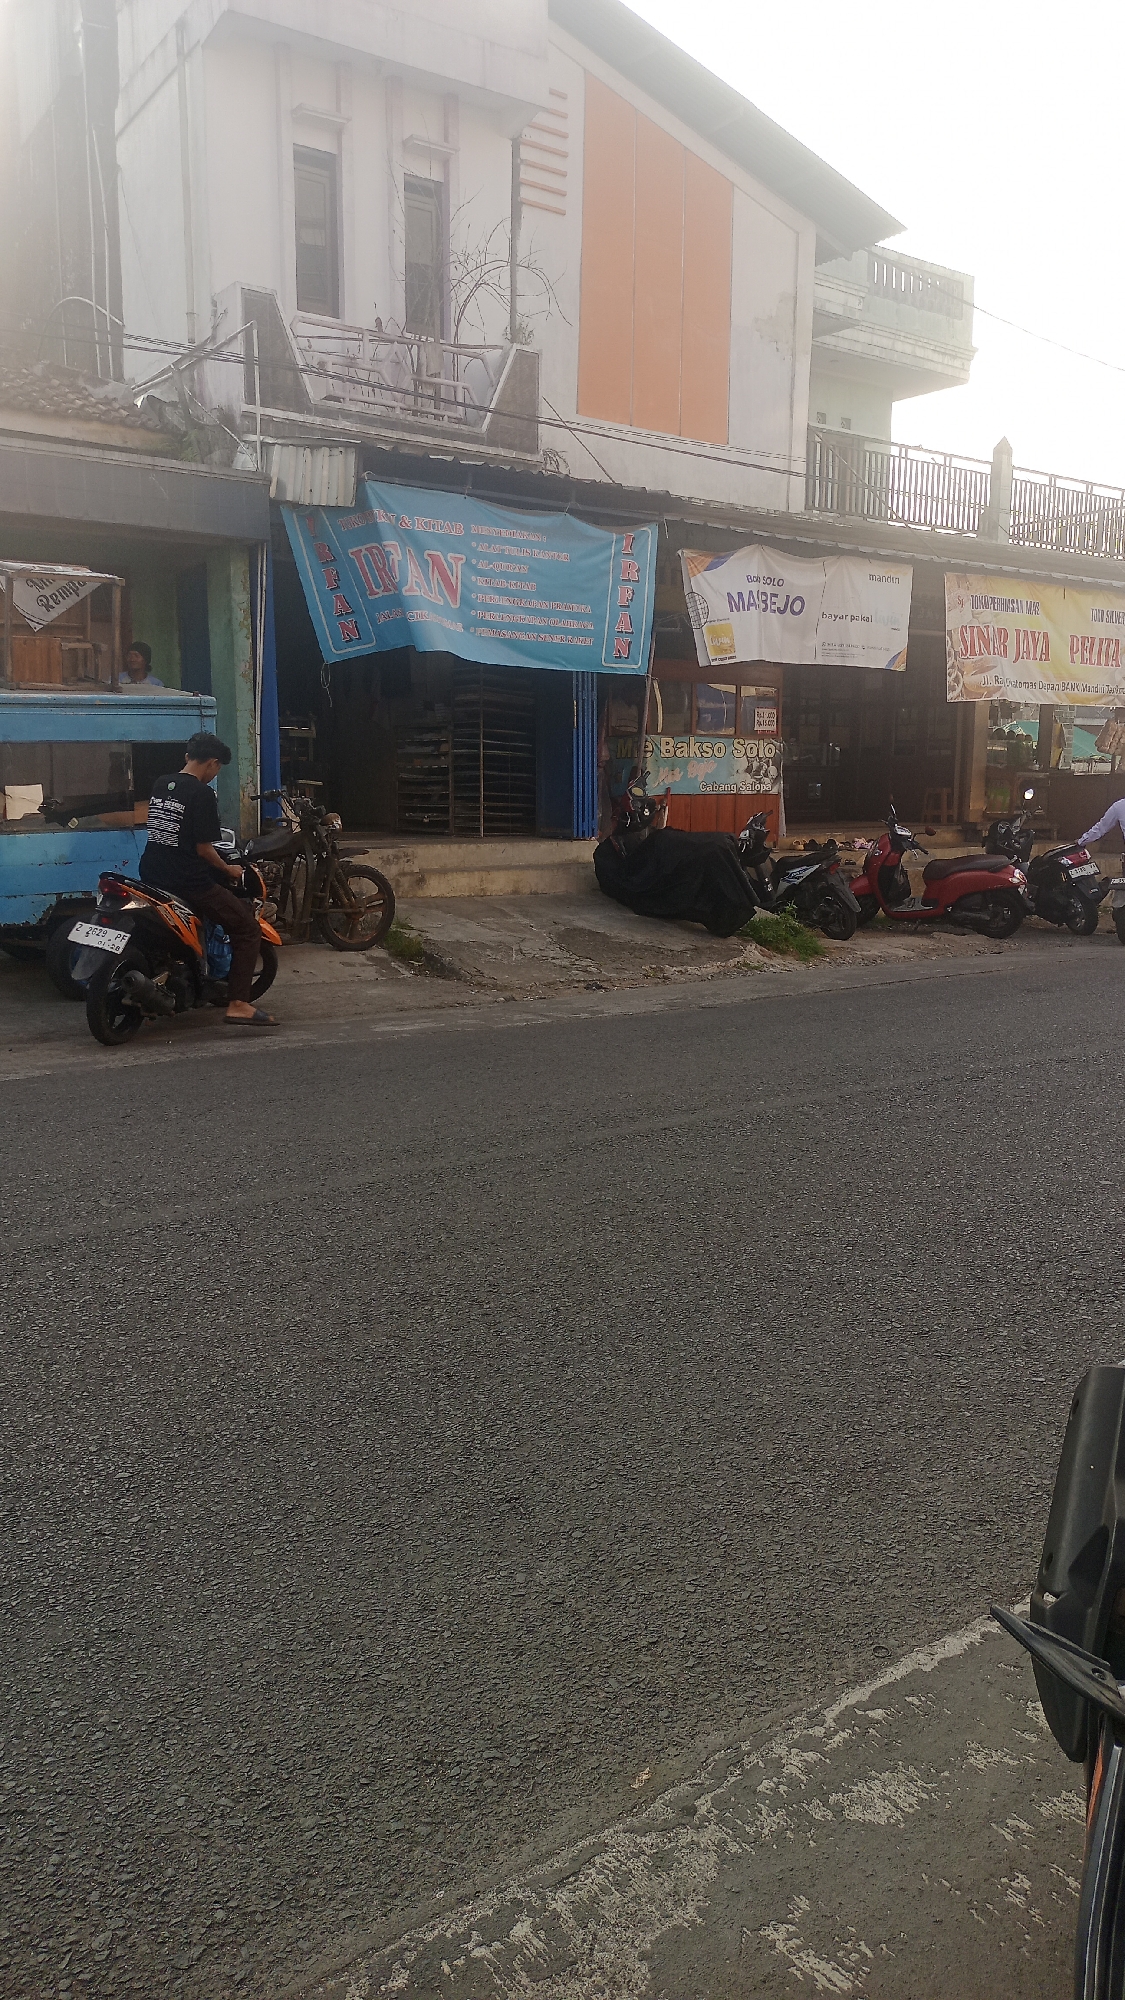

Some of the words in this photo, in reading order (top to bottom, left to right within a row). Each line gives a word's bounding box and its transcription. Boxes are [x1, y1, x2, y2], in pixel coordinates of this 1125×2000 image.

[399, 515, 413, 529] &
[414, 516, 465, 536] KITAB
[504, 545, 532, 557] TULIS
[532, 548, 570, 562] KANTOR
[348, 541, 467, 609] IRFAN
[477, 593, 550, 609] PERLENGKAPAN
[550, 601, 592, 614] PRAMUKA
[612, 532, 640, 659] IRFAN
[989, 596, 1024, 615] PERHIASAN
[1025, 600, 1040, 616] MAS
[477, 610, 548, 626] PERLENGKAPAN
[549, 617, 595, 630] OLAHRAGA
[821, 611, 849, 622] bayar
[475, 627, 538, 641] PEMASANGAN
[959, 624, 1010, 659] SINAR
[1012, 628, 1051, 664] JAYA
[1069, 634, 1122, 668] PELITA
[1038, 680, 1060, 692] Depan
[1061, 681, 1080, 692] BANK
[1081, 683, 1104, 694] Mandiri
[660, 735, 727, 759] Bakso
[732, 737, 777, 759] Solo
[700, 781, 738, 793] Cabang
[740, 781, 772, 793] Salopa
[76, 923, 83, 932] Z
[86, 926, 108, 938] 2629
[114, 933, 128, 943] PF
